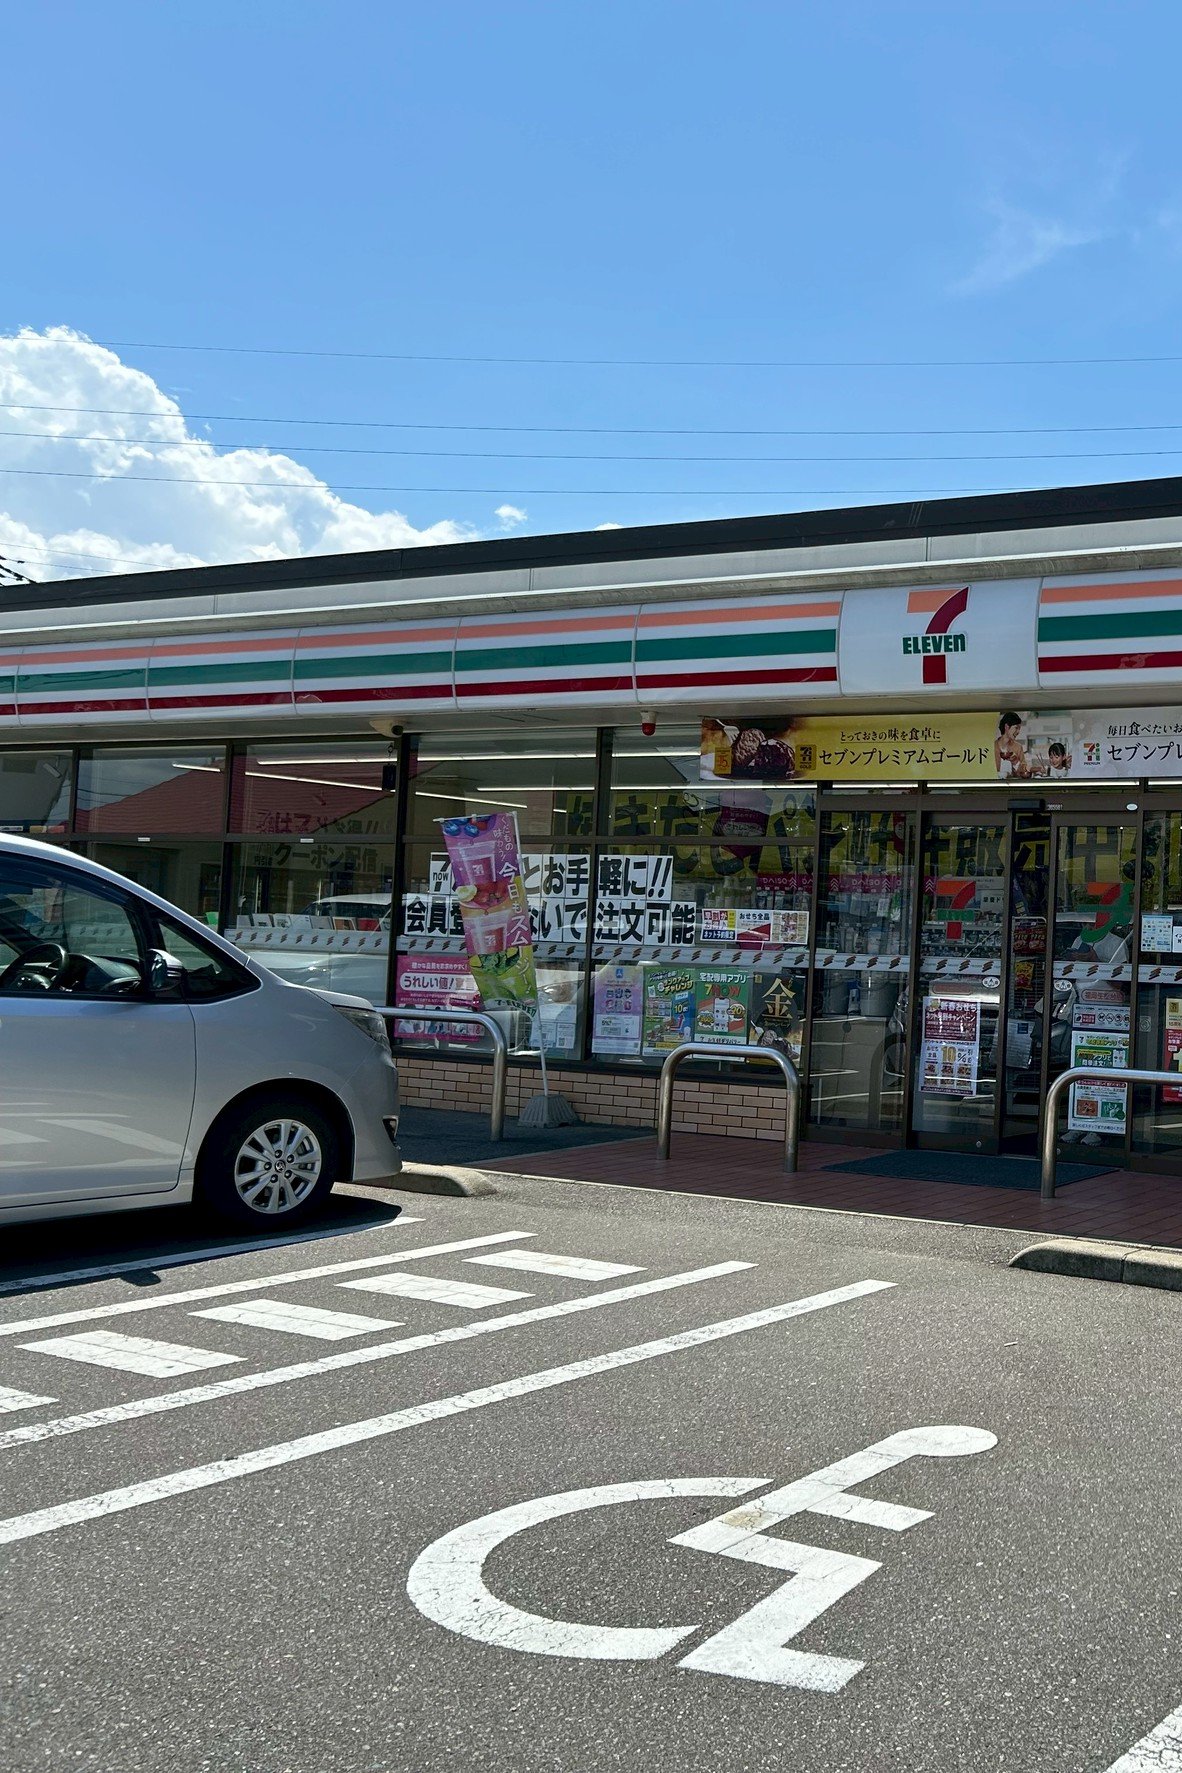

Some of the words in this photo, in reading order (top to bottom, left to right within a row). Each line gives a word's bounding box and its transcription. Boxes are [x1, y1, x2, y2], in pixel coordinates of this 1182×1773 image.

[840, 727, 941, 741] とっておきの味を食卓に
[818, 747, 989, 766] セブンプレミアムゴールド
[739, 912, 770, 921] おせち全品
[761, 977, 796, 1019] 金
